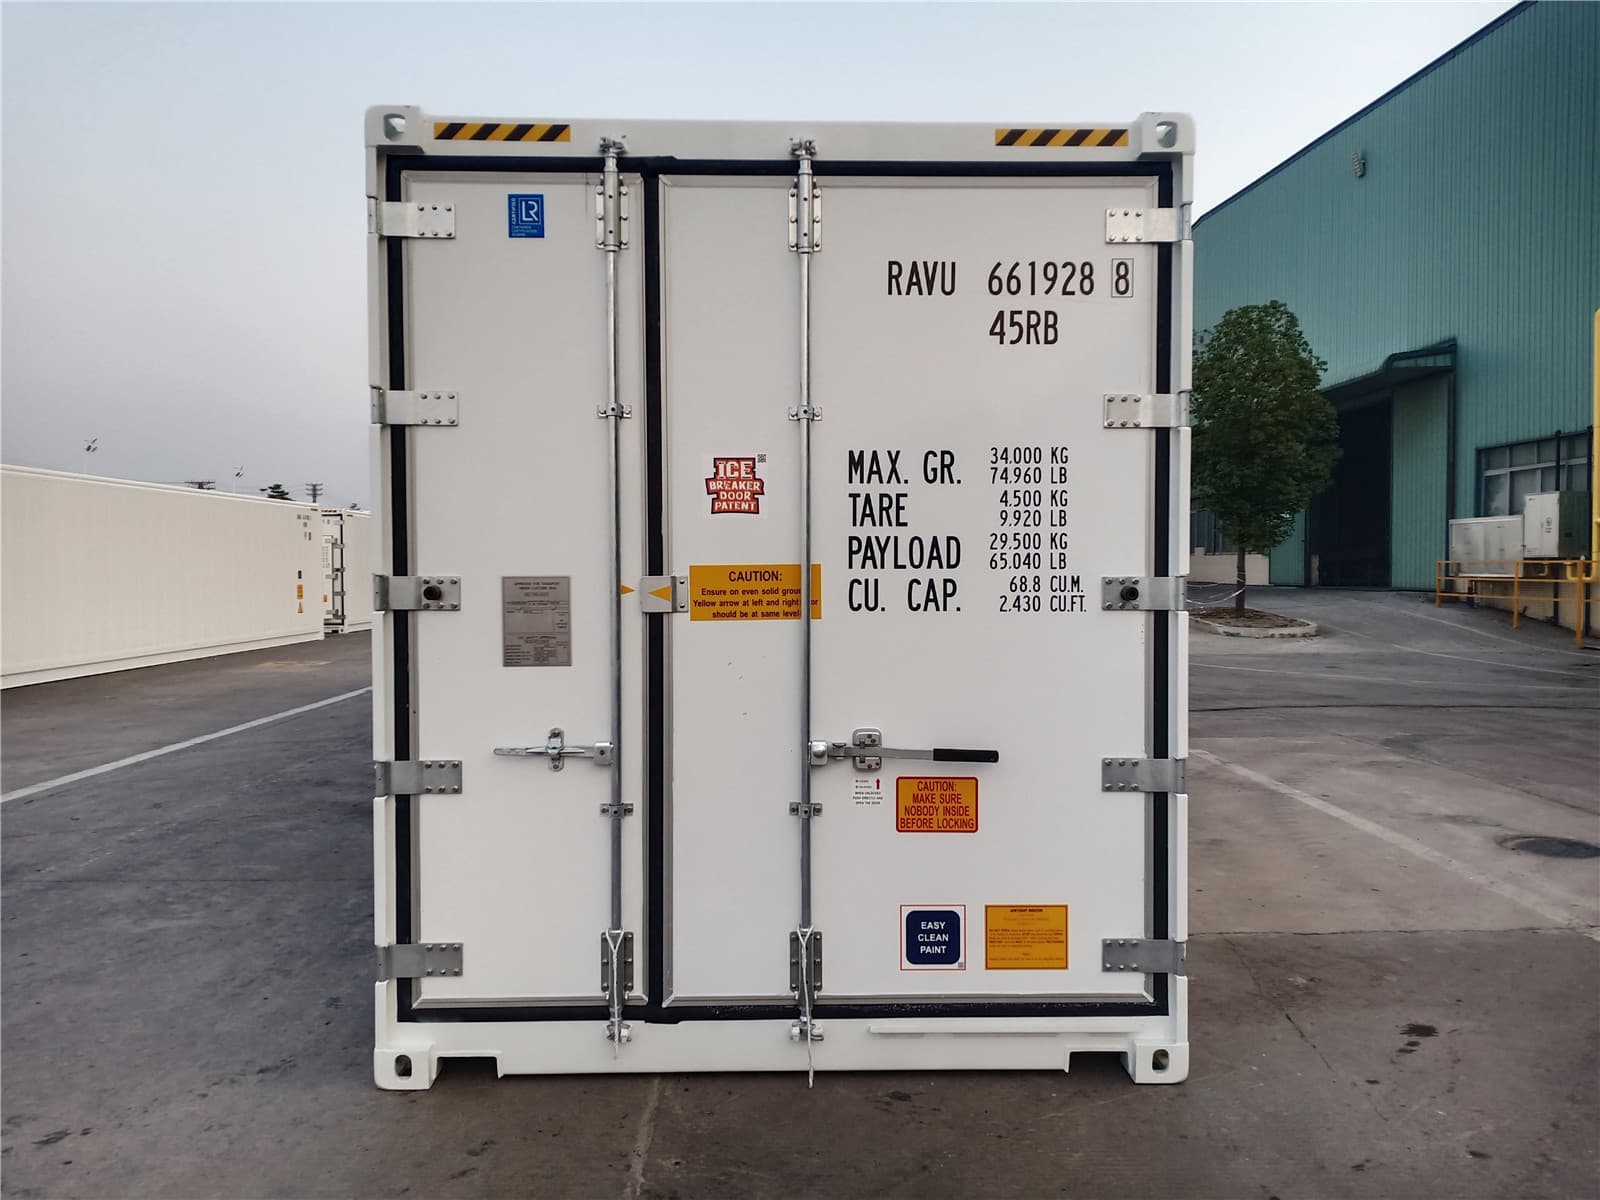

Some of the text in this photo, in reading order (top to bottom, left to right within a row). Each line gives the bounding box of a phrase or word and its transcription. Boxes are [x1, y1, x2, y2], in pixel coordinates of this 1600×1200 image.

[522, 201, 538, 221] LR
[887, 261, 1130, 296] RAVU 661928 8
[989, 310, 1059, 345] 45RB
[1051, 447, 1069, 464] KG
[716, 461, 753, 479] ICE
[848, 450, 962, 484] MAX. GR.
[1051, 467, 1067, 484] LB
[709, 480, 760, 490] BREAKER
[719, 491, 751, 501] DOOR
[1051, 490, 1068, 507] KG
[714, 501, 756, 511] PATENT
[848, 493, 908, 527] TARE
[1051, 510, 1067, 527] LB
[1050, 533, 1068, 550] KG
[848, 536, 961, 569] PAYLOAD
[1050, 552, 1066, 569] LB
[728, 570, 783, 582] CAUTION:
[1009, 576, 1084, 593] 68.8 CU.M.
[701, 588, 727, 596] Ensure
[761, 587, 779, 595] solid
[848, 578, 961, 612] CU. CAP.
[693, 599, 717, 607] Yellow
[782, 598, 799, 608] right
[1050, 595, 1087, 612] CU.FT.
[712, 610, 737, 618] should
[739, 610, 749, 618] be
[917, 780, 957, 792] CAUTION:
[912, 793, 962, 804] MAKE SURE
[904, 806, 970, 817] NOBODY INSIDE
[900, 818, 974, 829] BEFORE LOCKING
[920, 921, 946, 930] EASY
[917, 933, 949, 942] CLEAN
[920, 945, 946, 954] PAINT
